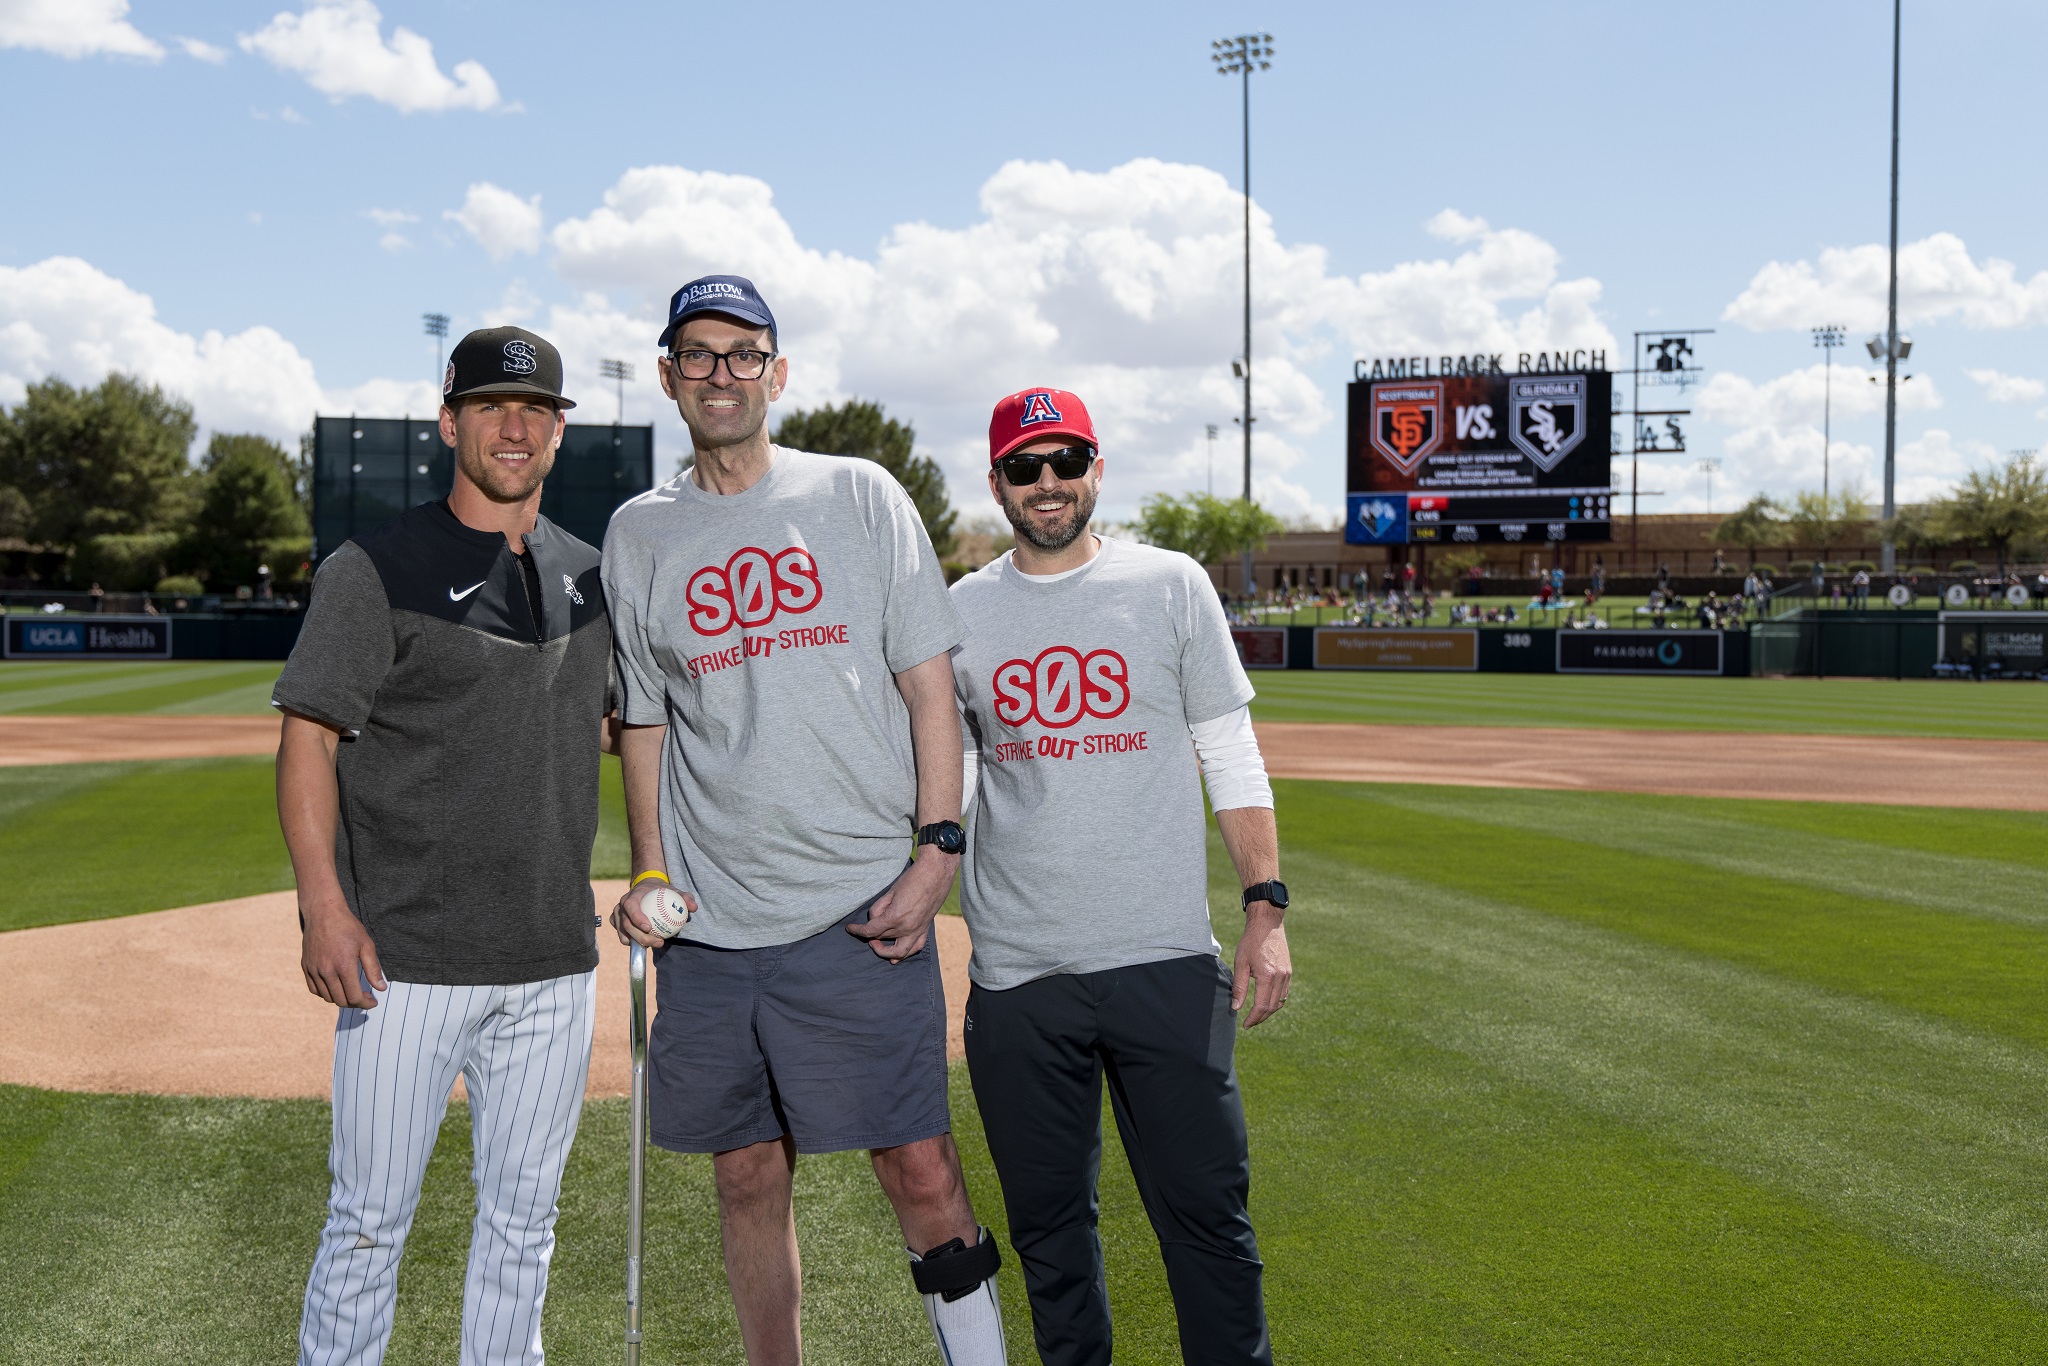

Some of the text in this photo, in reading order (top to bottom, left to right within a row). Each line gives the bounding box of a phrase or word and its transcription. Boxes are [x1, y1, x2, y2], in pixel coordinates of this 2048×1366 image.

[689, 283, 743, 300] Barrow
[689, 292, 722, 304] Neurological
[1354, 349, 1605, 381] CAMELBACK RANCH
[1377, 388, 1436, 401] SCOTTSDALE
[1518, 382, 1577, 397] GLENDALE
[1020, 393, 1062, 428] A
[1391, 405, 1426, 456] SF
[1455, 404, 1497, 440] VS.
[1428, 455, 1456, 465] STRIKE
[1456, 455, 1473, 464] OUT
[1415, 511, 1440, 522] CWS
[30, 626, 156, 648] UCLA Health
[1503, 633, 1532, 648] 380
[687, 625, 850, 679] STRIKE OUT STROKE
[1594, 646, 1656, 658] PARADOX
[996, 731, 1148, 763] STRIKE OUT STROKE
